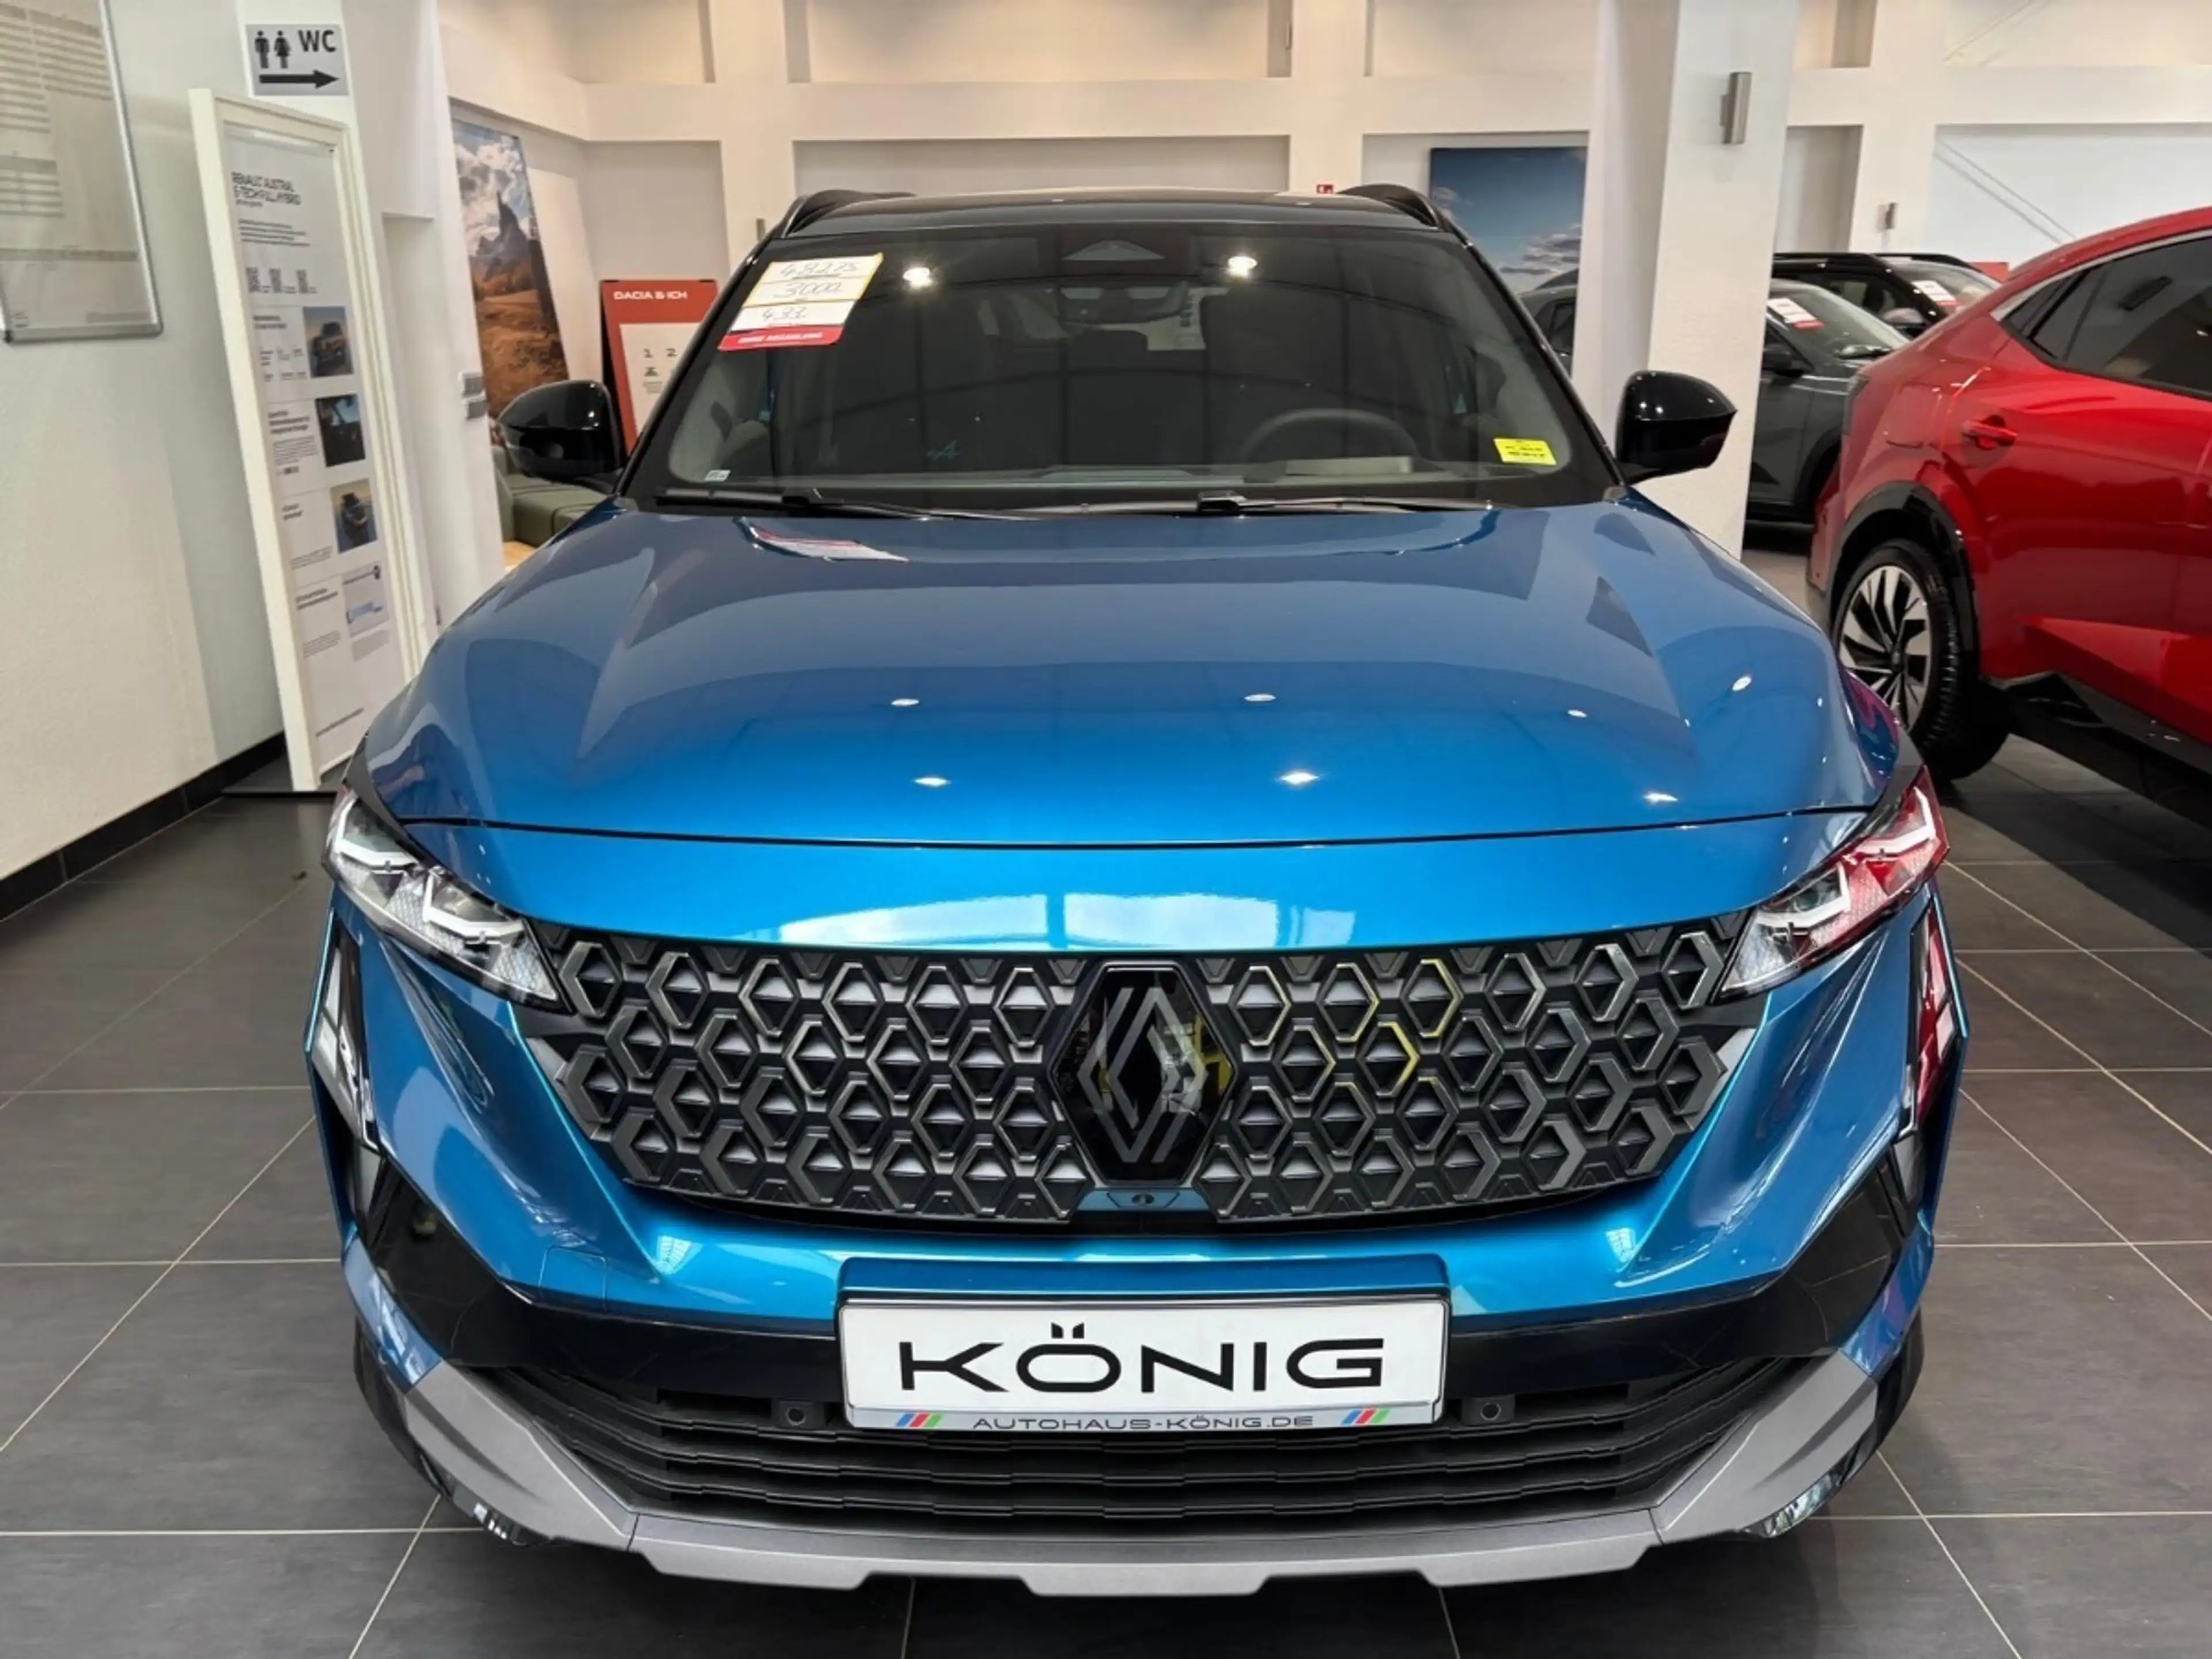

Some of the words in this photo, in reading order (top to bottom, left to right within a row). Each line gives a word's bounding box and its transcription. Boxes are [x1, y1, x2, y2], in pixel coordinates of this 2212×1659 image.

[298, 29, 336, 52] WC
[613, 290, 653, 300] DACIA
[899, 1322, 1384, 1393] KÖNIG
[974, 1415, 1313, 1430] AUTOHAUS-KÖNIG.DE
